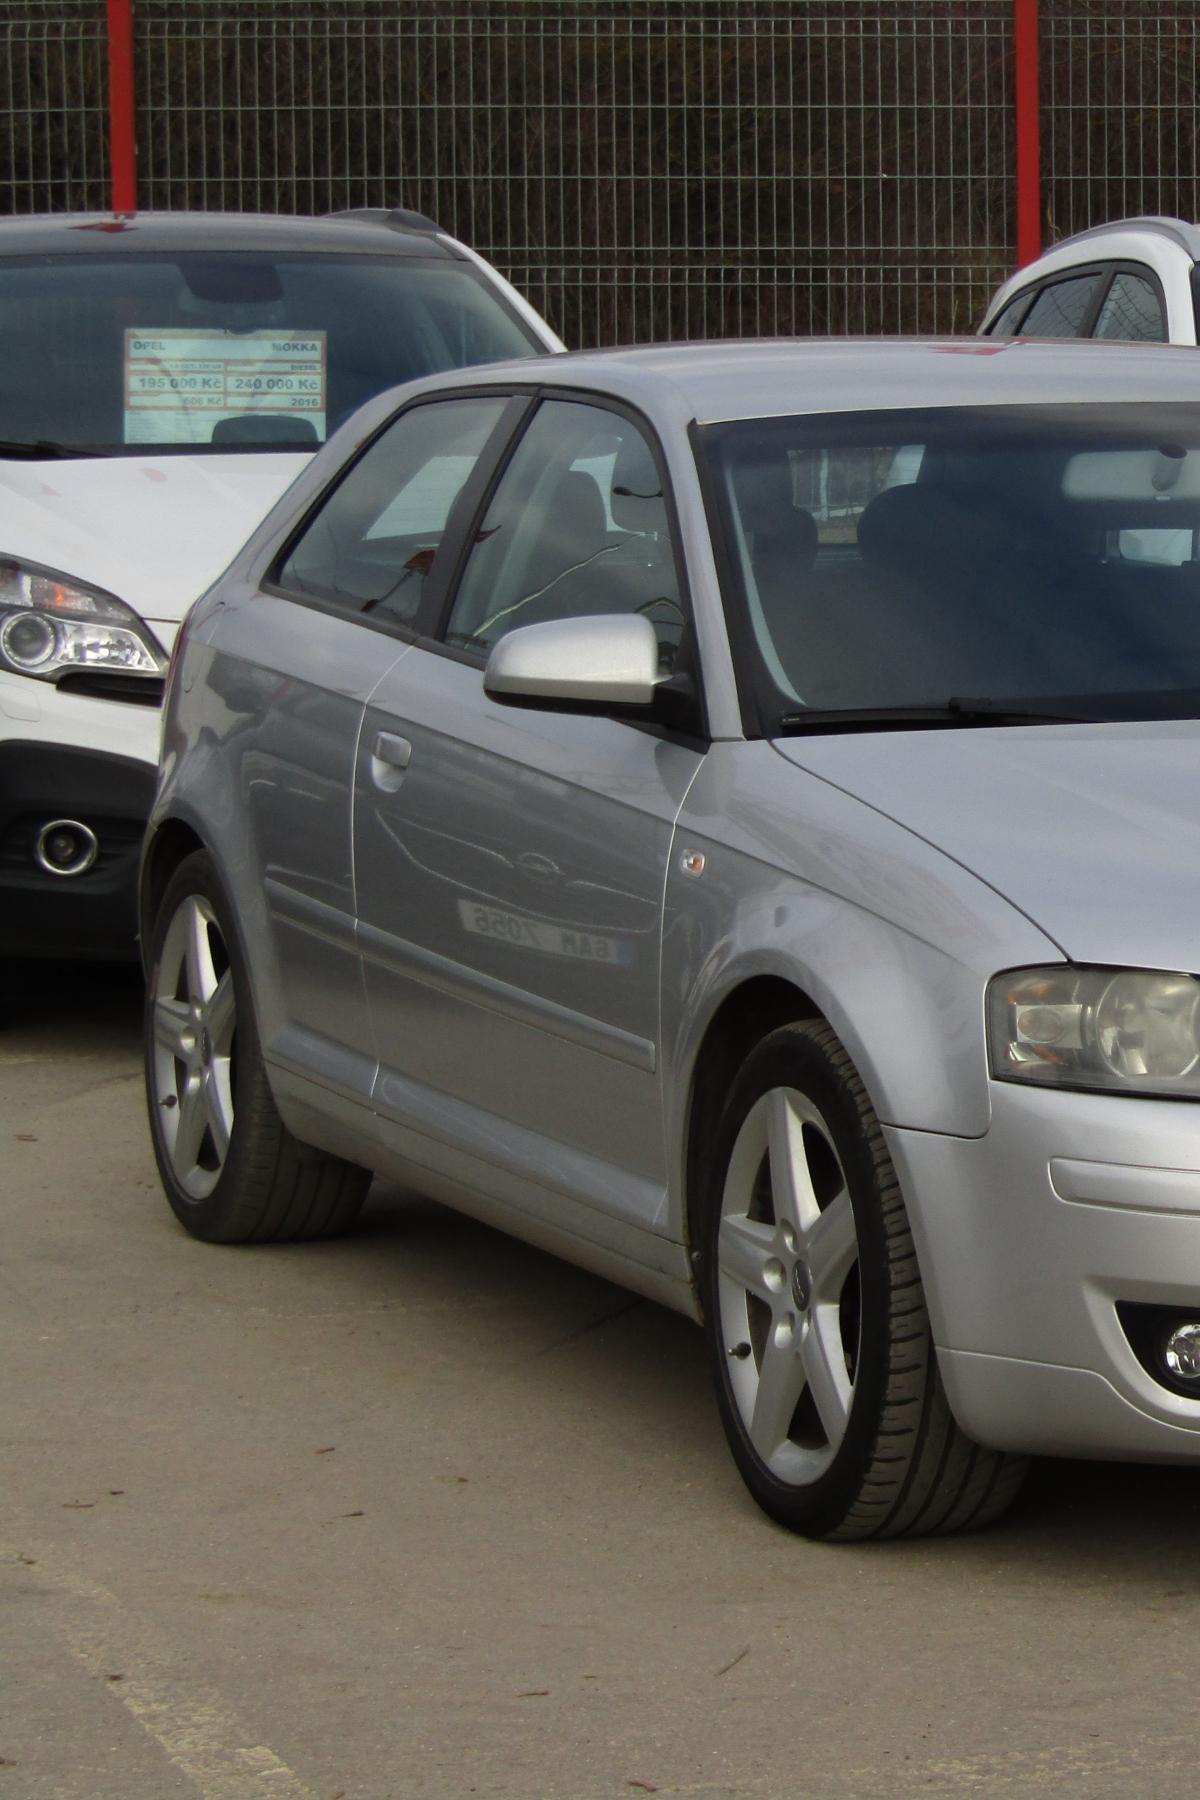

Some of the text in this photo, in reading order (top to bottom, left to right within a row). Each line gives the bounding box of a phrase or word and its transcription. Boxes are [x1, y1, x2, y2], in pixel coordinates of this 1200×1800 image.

[133, 341, 165, 351] OPEL
[272, 342, 318, 352] MOKKA
[139, 377, 222, 389] 195 000 Kč
[235, 378, 318, 390] 240 000 Kč
[291, 398, 318, 407] 2016
